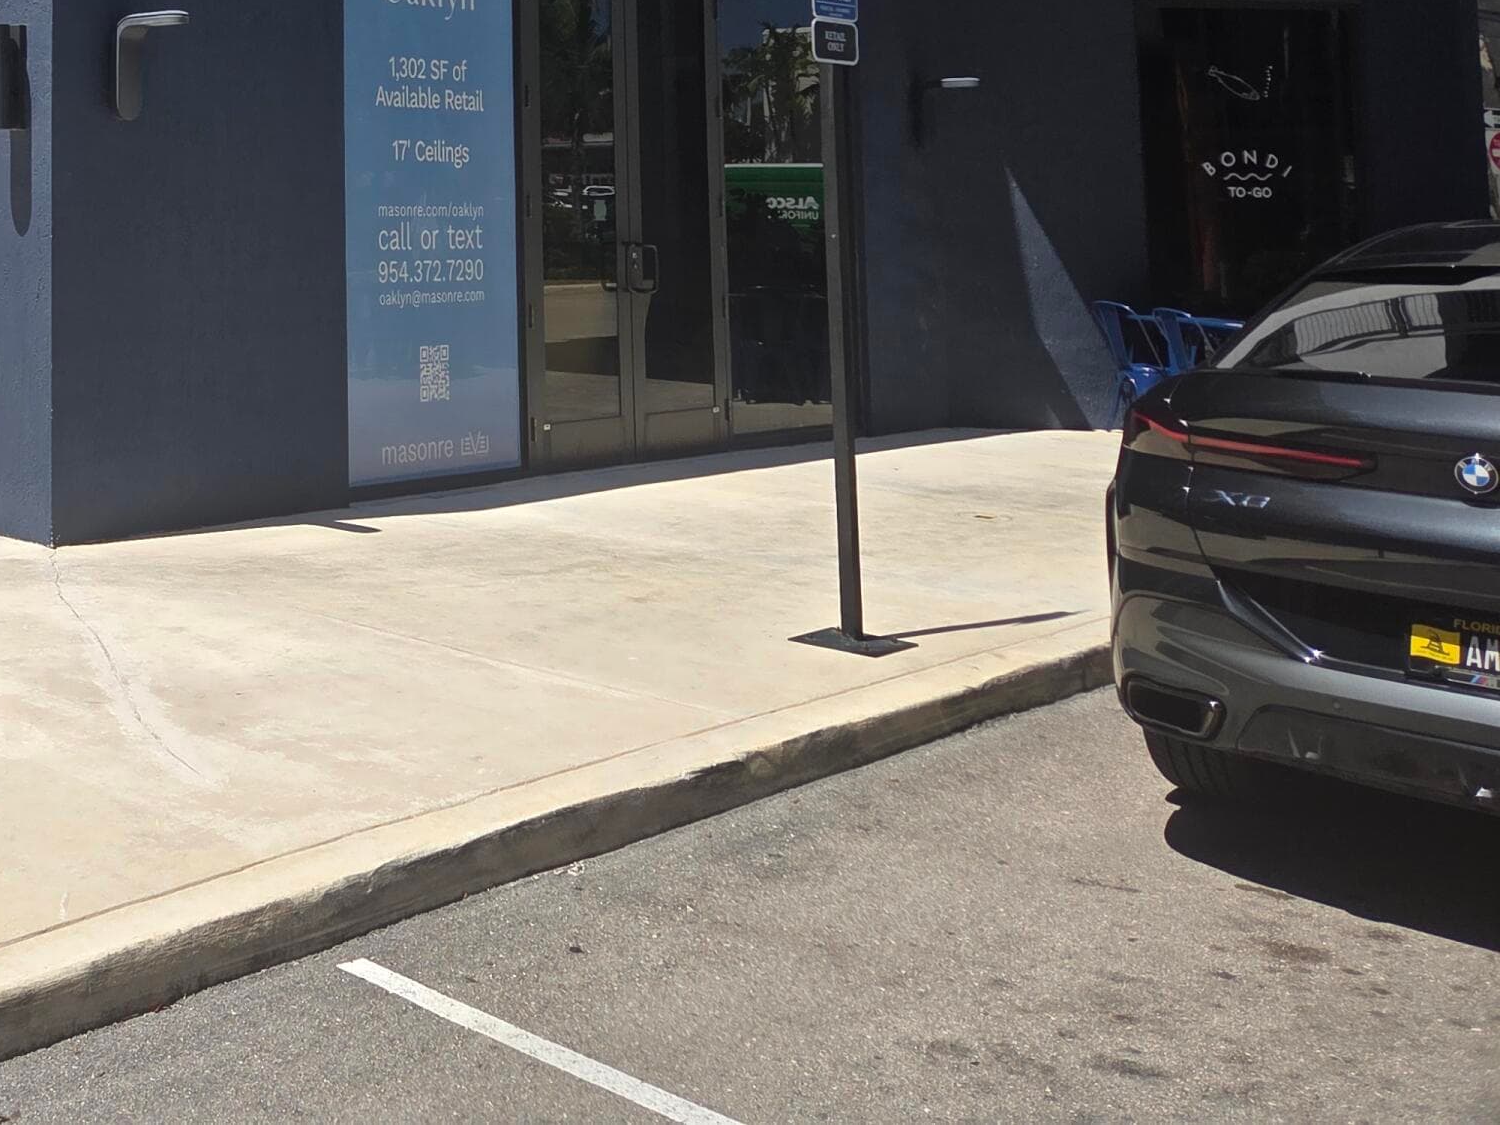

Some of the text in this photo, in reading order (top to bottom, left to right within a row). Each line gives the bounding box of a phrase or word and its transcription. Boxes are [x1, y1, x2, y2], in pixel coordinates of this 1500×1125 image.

[389, 56, 468, 83] 1,302 SF of
[375, 85, 485, 112] Available Retail
[392, 140, 470, 169] 17' Ceilings
[1202, 150, 1292, 177] BONDI
[1227, 186, 1273, 199] TO-GO
[378, 203, 484, 221] masonre.com/oaklyn
[378, 221, 484, 252] call or text
[378, 258, 484, 284] 954.372.7290
[379, 288, 485, 310] oaklyn@masonre.com
[381, 437, 454, 466] masonre
